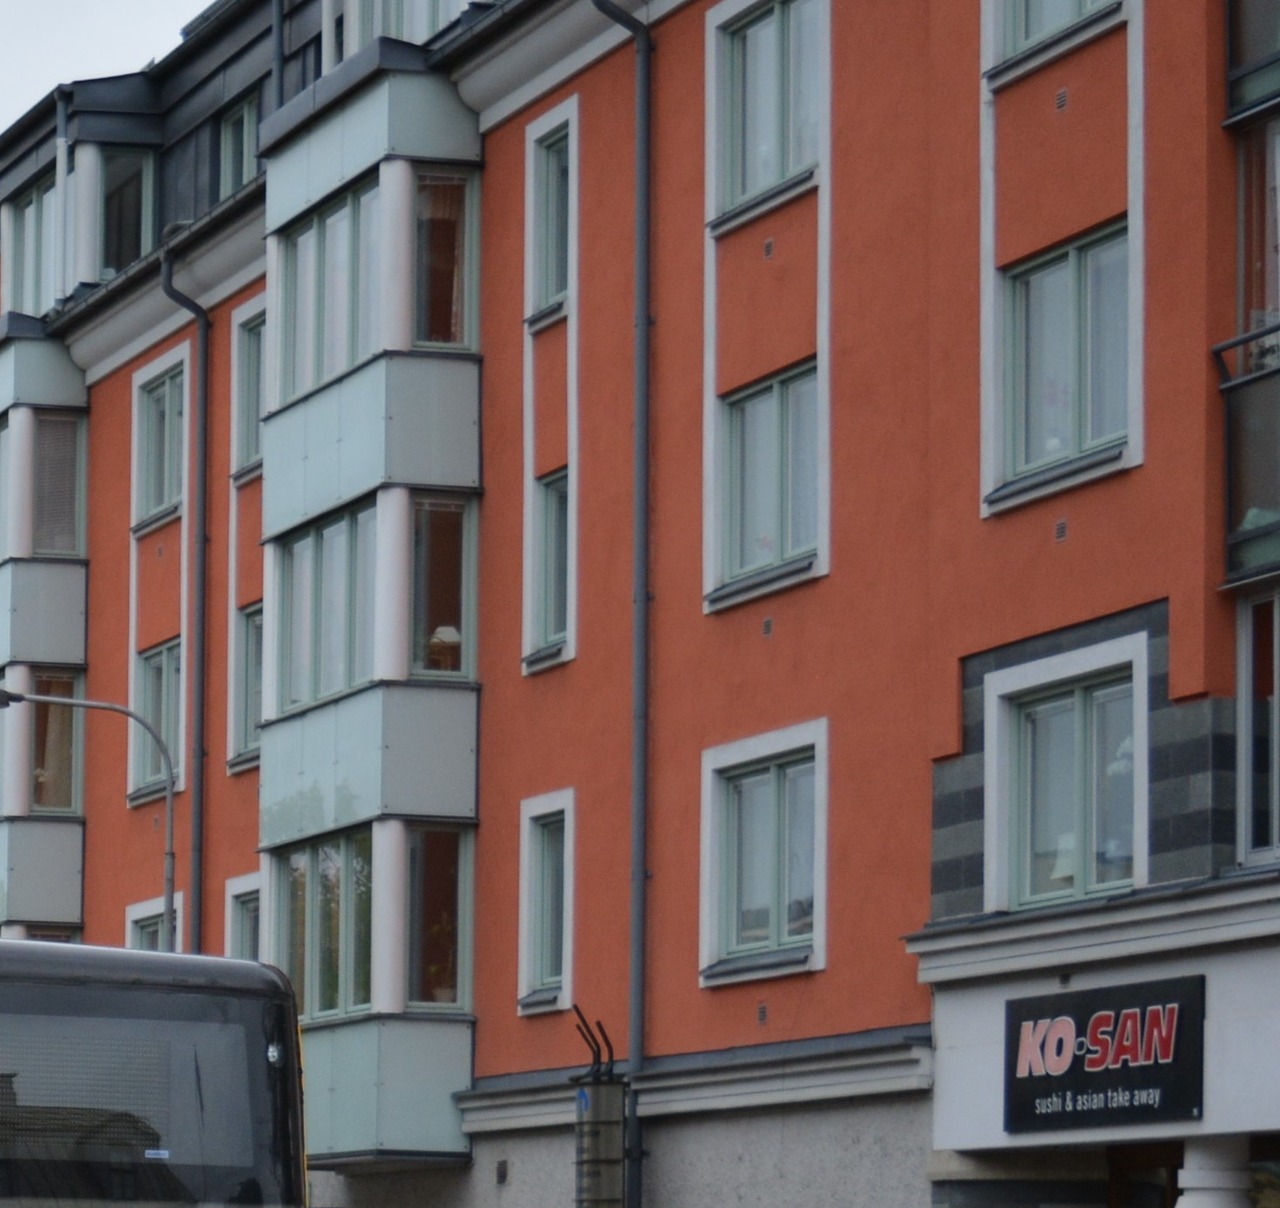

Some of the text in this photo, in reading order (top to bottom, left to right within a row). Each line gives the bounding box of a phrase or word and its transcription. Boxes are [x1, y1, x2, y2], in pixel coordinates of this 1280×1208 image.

[1035, 1087, 1160, 1114] sushi & asian take away
